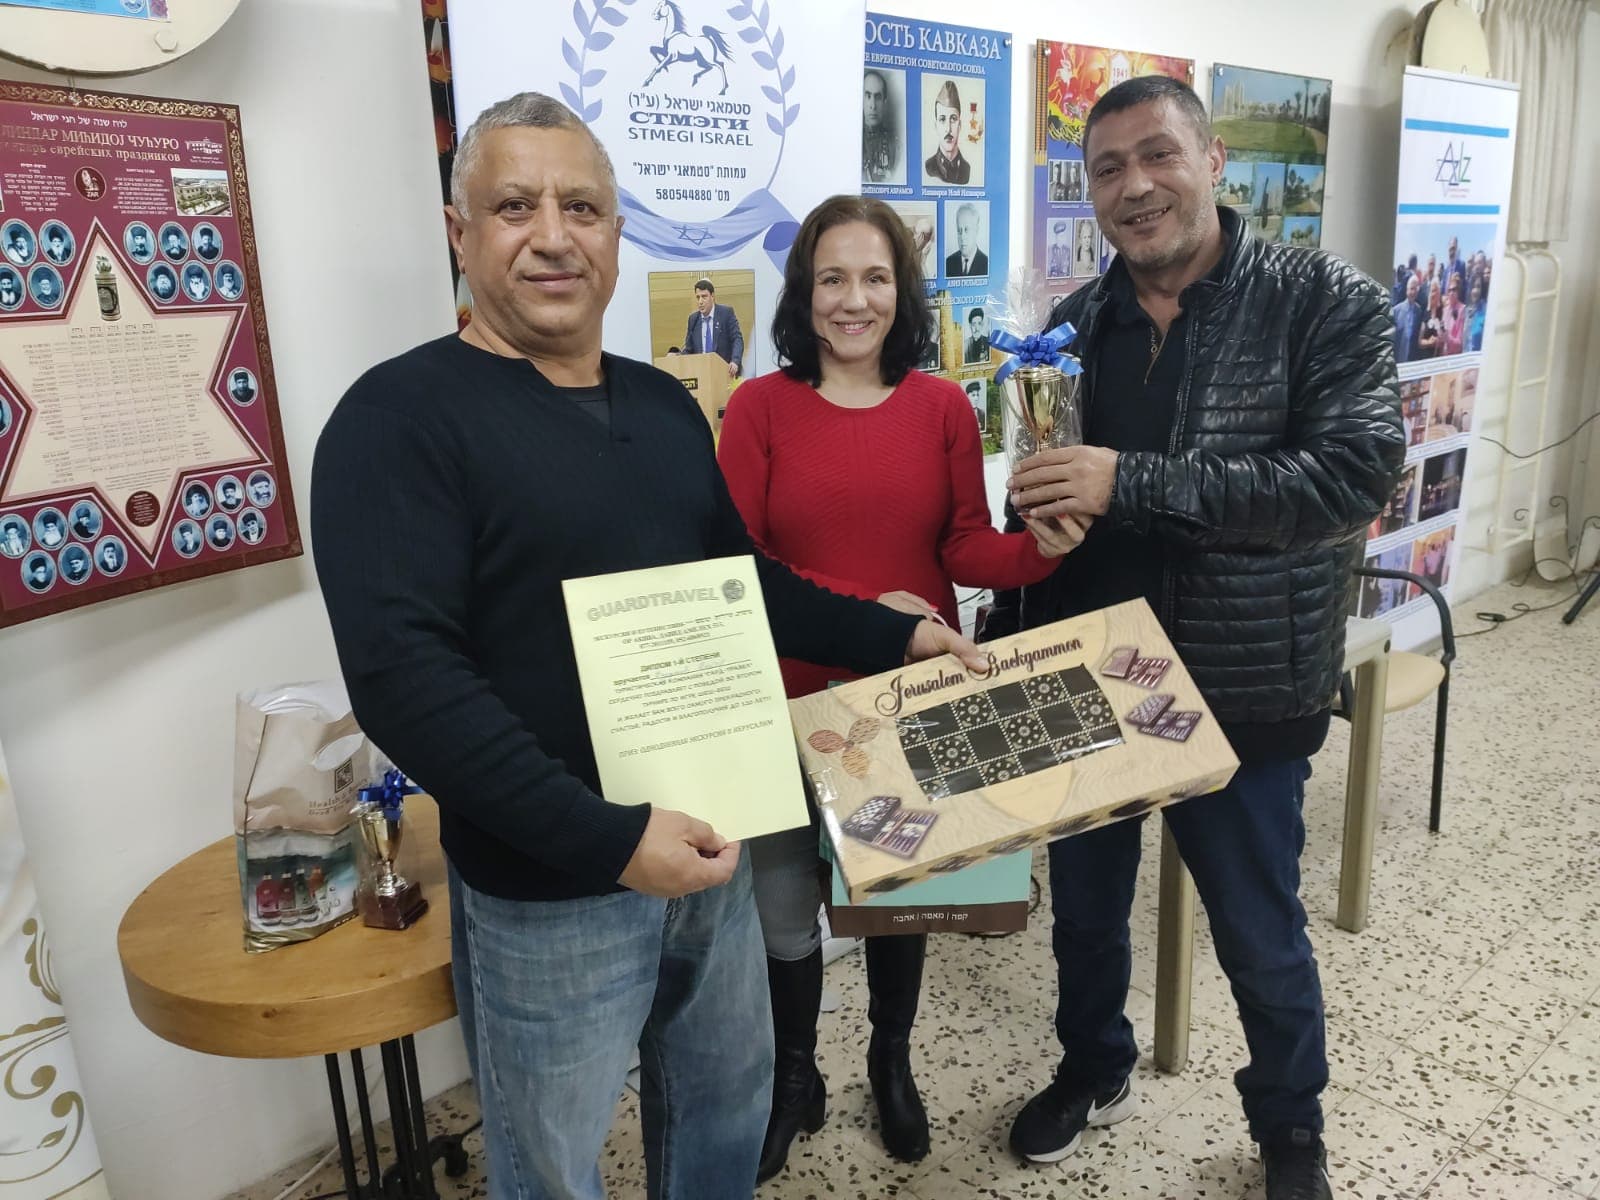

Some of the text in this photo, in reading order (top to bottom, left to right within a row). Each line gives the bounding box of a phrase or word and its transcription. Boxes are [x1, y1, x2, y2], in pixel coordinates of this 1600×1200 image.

[918, 27, 1002, 60] КАВКАЗА
[917, 59, 962, 72] СОВЕТСКОГО
[962, 64, 986, 75] СОЮЗА
[664, 94, 703, 110] ישראל
[707, 100, 751, 115] סטמאגי
[30, 110, 59, 122] ישראל
[629, 111, 750, 131] СТМЭГИ
[628, 127, 754, 147] STMEGI ISRAEL
[116, 149, 181, 162] праздников
[716, 166, 746, 179] עמותת
[655, 188, 712, 201] 580544880
[875, 637, 1083, 717] Jerusalem Backgammon
